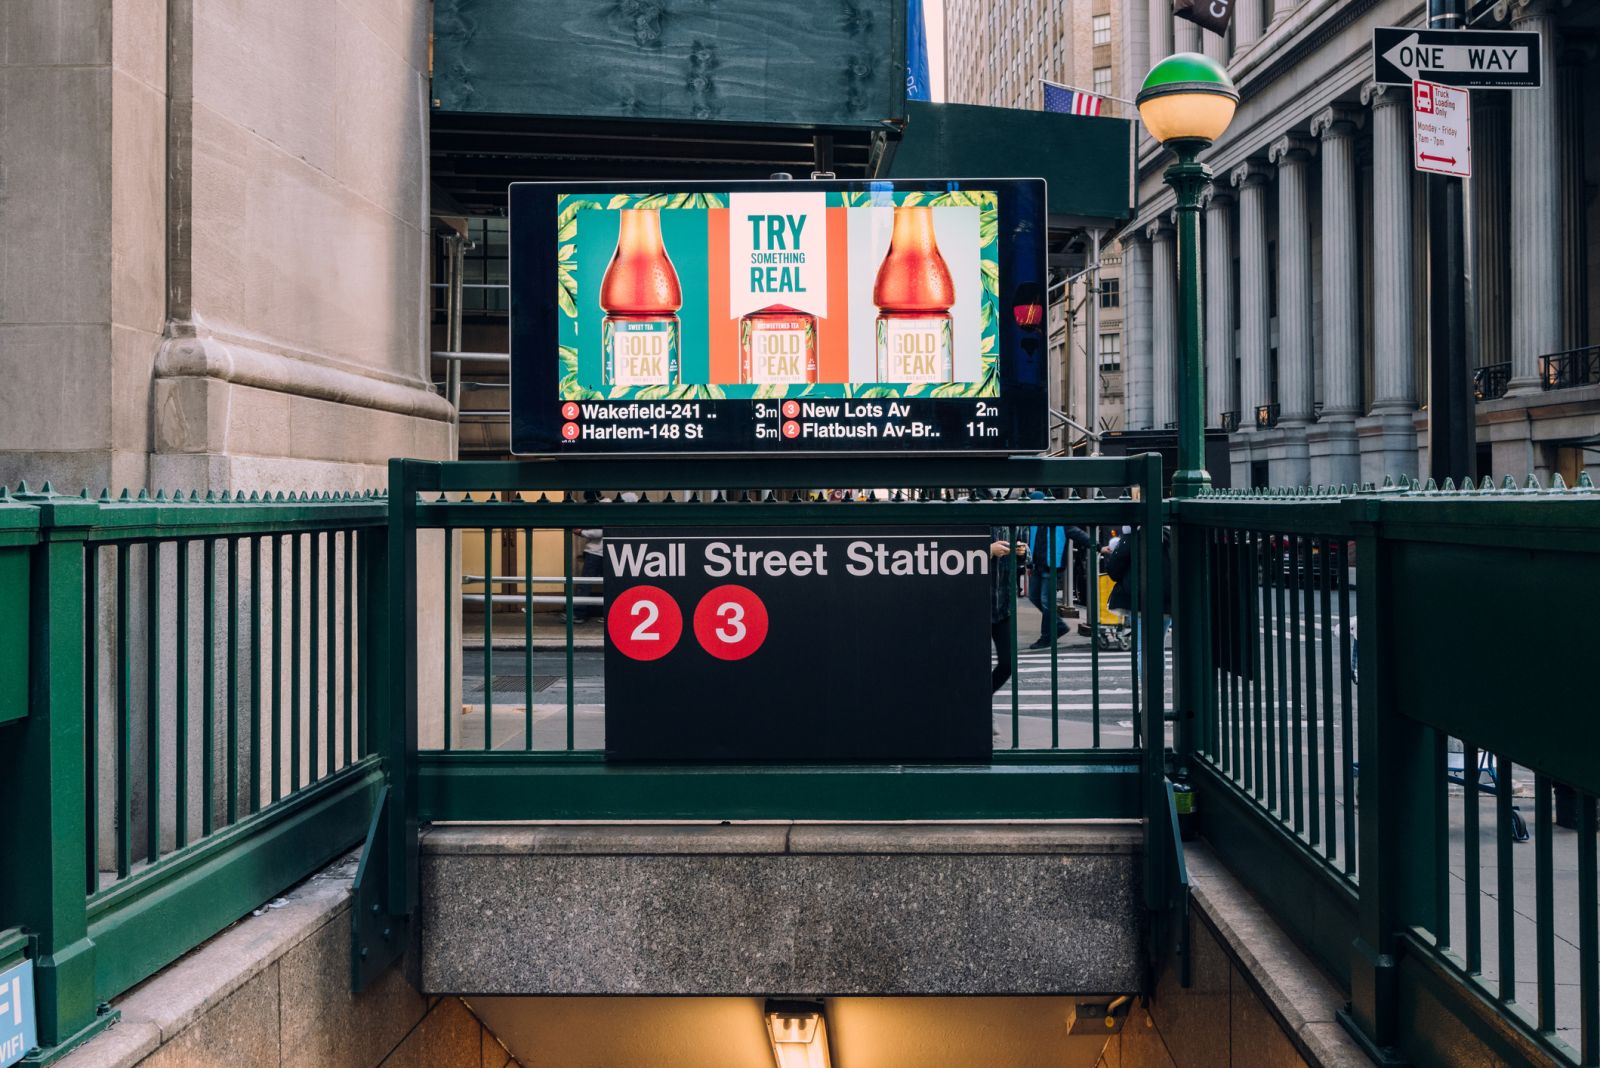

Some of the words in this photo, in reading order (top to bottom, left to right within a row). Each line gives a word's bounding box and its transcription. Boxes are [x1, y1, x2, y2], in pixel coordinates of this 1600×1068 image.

[1400, 46, 1444, 68] ONE
[1468, 48, 1518, 70] WAY
[1435, 88, 1449, 98] Truck
[1435, 98, 1455, 110] Loading
[1436, 108, 1447, 118] Only
[1418, 122, 1437, 134] Monday
[1442, 126, 1458, 139] Friday
[1418, 134, 1429, 143] 7am
[1434, 137, 1445, 146] 7pm
[748, 214, 807, 250] TRY
[751, 252, 806, 264] SOMETHING
[750, 266, 806, 292] REAL
[620, 336, 662, 356] GOLD
[758, 334, 800, 355] GOLD
[894, 334, 936, 354] GOLD
[620, 357, 662, 376] PEAK
[758, 356, 800, 375] PEAK
[894, 355, 936, 375] PEAK
[568, 407, 574, 416] 2
[582, 404, 700, 419] Wakefield-241
[756, 404, 777, 418] 3m
[788, 406, 795, 414] 3
[803, 403, 839, 418] New
[844, 403, 882, 417] Lots
[888, 403, 910, 417] Av
[976, 402, 998, 416] 2m
[568, 426, 574, 436] 3
[582, 424, 680, 439] Harlem-148
[685, 424, 703, 439] St
[755, 424, 777, 438] 5m
[788, 425, 795, 434] 2
[803, 422, 878, 438] Flatbush
[883, 422, 940, 437] Av-Br..
[967, 422, 998, 436] 11m
[607, 543, 686, 577] Wall
[703, 542, 828, 576] Street
[846, 541, 988, 576] Station
[630, 600, 660, 641] 2
[715, 602, 746, 644] 3
